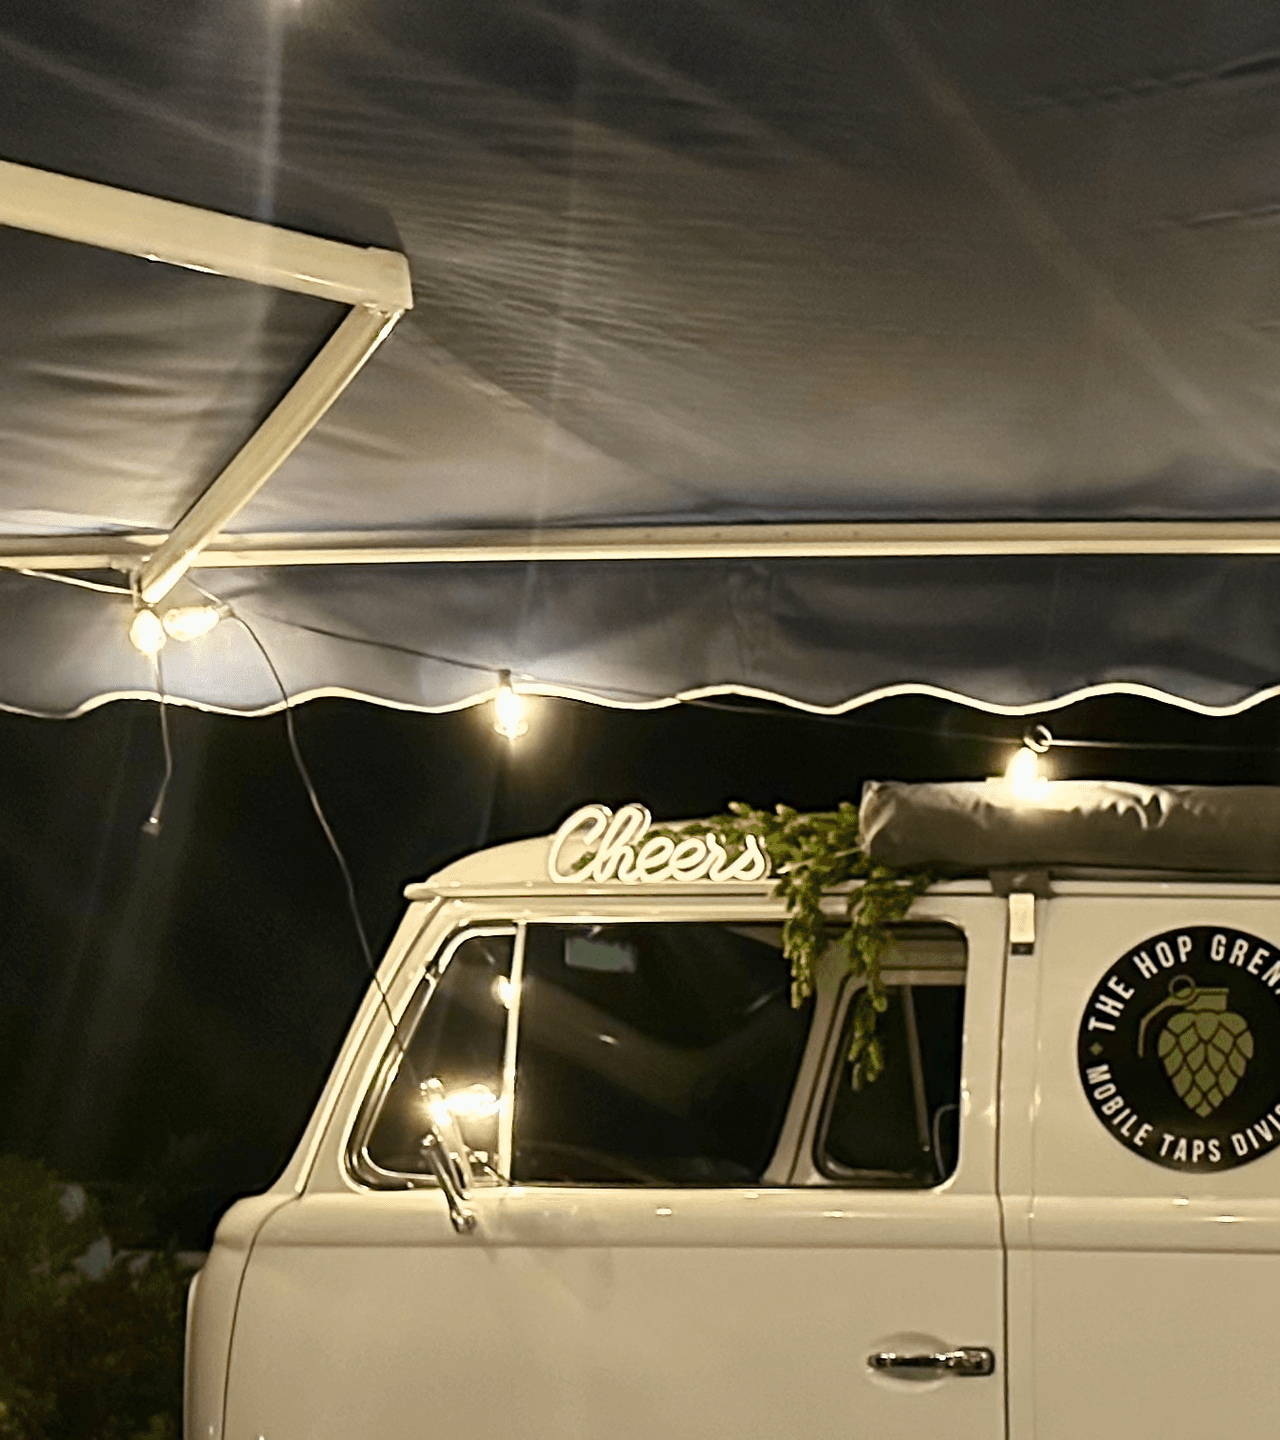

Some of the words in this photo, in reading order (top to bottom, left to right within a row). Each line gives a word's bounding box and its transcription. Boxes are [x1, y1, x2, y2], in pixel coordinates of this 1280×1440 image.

[548, 803, 772, 884] Cheers
[1088, 975, 1136, 1032] THE
[1133, 935, 1193, 979] HOP
[1086, 1064, 1154, 1147] MOBILE
[1159, 1133, 1221, 1163] TAPS
